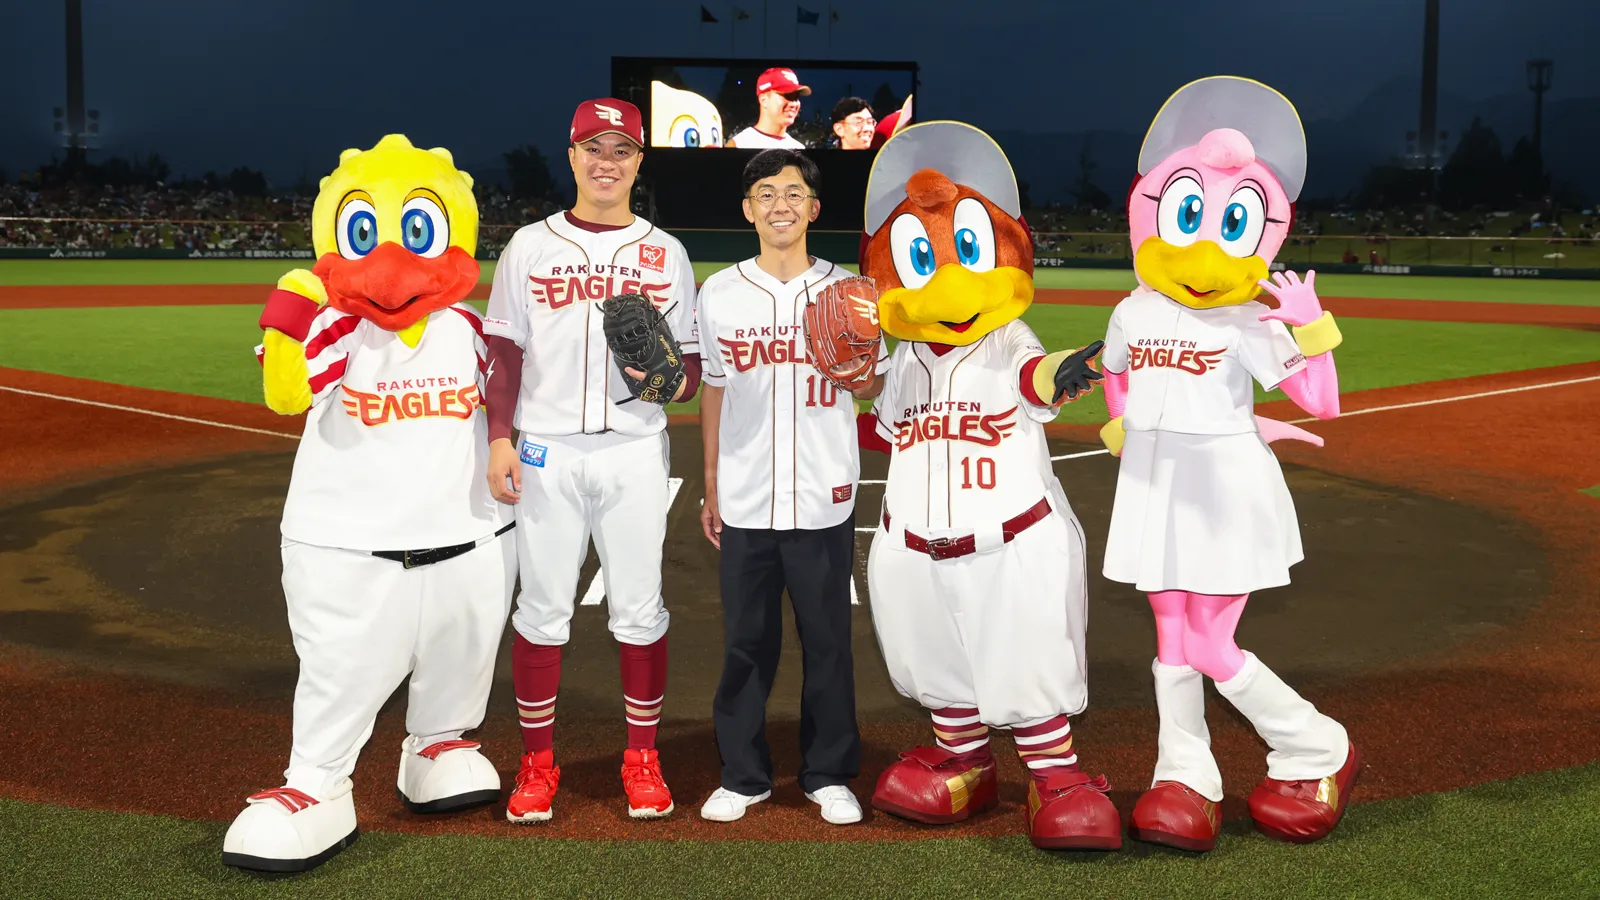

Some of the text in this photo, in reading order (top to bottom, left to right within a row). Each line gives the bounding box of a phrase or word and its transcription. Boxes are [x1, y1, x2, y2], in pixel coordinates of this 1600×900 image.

[552, 264, 642, 279] RAKUTEN
[735, 325, 801, 339] RAKUT
[1137, 338, 1197, 349] RAKUTEN
[717, 336, 813, 373] EAGL
[1127, 343, 1228, 376] EAGLES
[377, 376, 458, 392] RAKUTEN
[806, 375, 836, 407] 10
[341, 382, 480, 427] EAGLES
[903, 401, 981, 419] RAKUTEN
[893, 405, 1018, 452] EAGLES
[961, 456, 996, 490] 10
